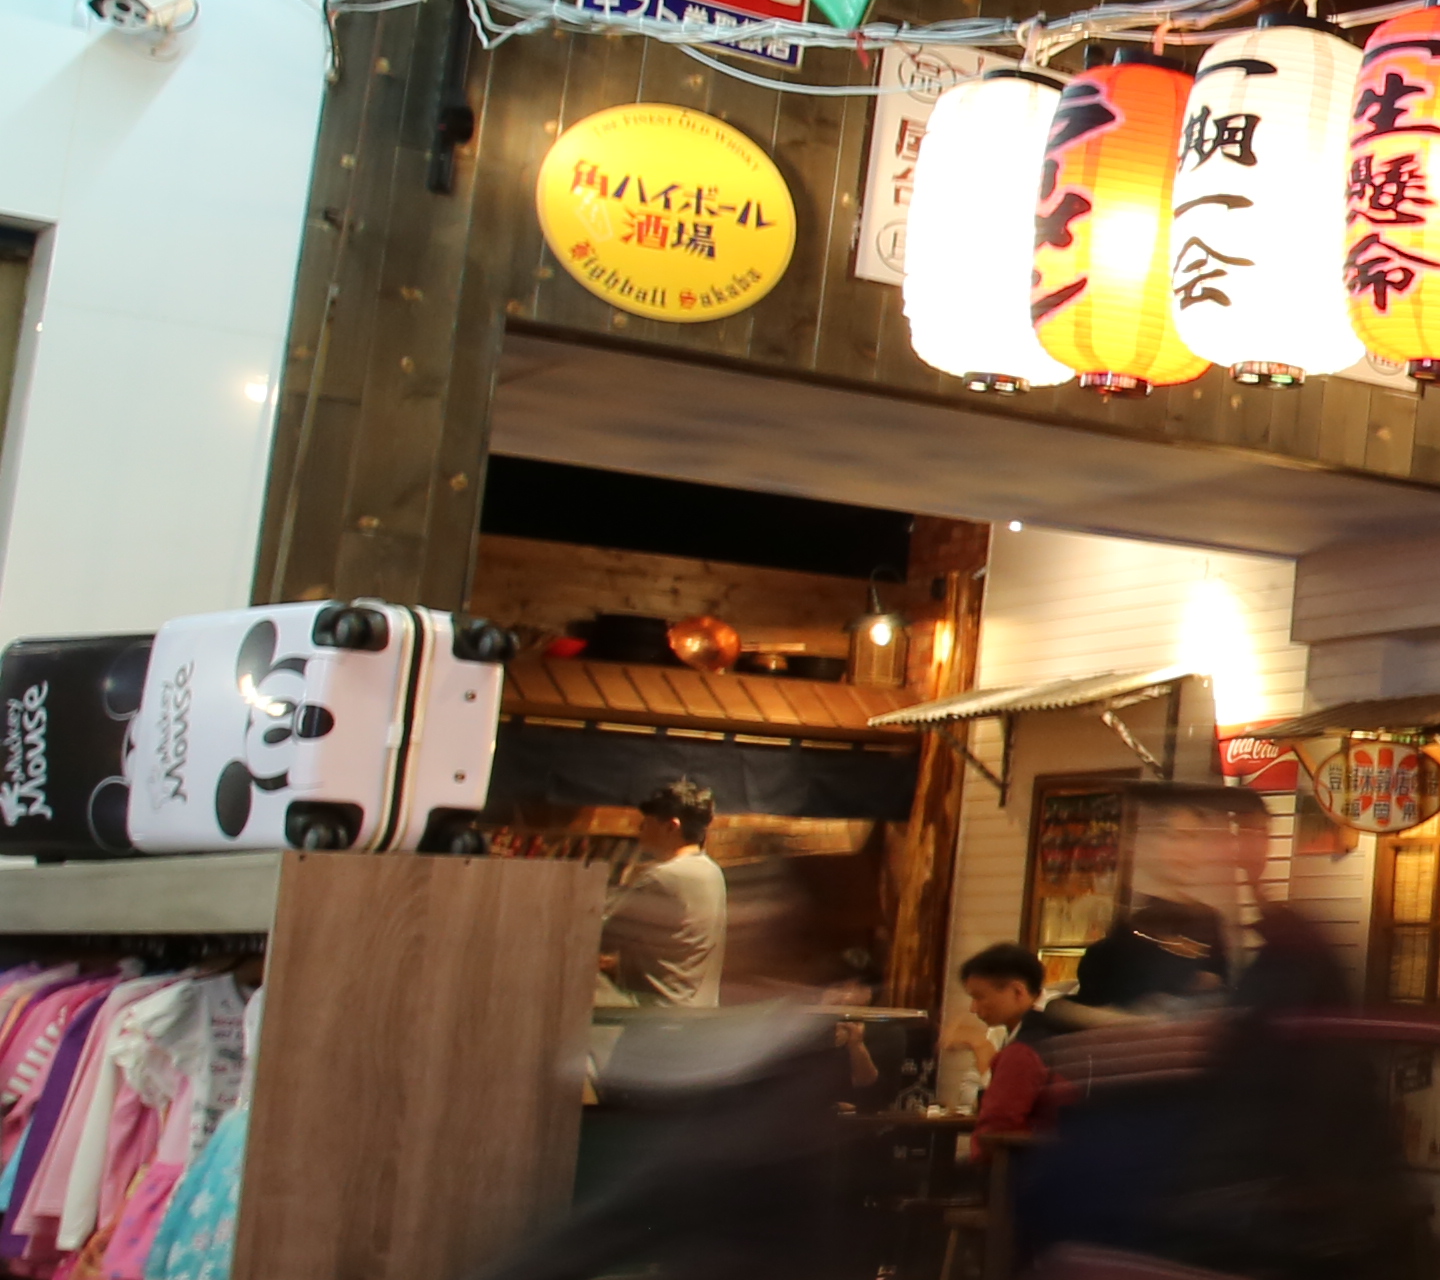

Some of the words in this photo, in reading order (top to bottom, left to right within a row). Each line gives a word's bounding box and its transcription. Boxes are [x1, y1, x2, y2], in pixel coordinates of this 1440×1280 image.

[570, 160, 777, 230] 角ハイボール
[620, 208, 716, 260] 酒場
[1173, 58, 1276, 309] 一期一会
[19, 680, 53, 820] Mouse
[162, 659, 195, 804] Mouse
